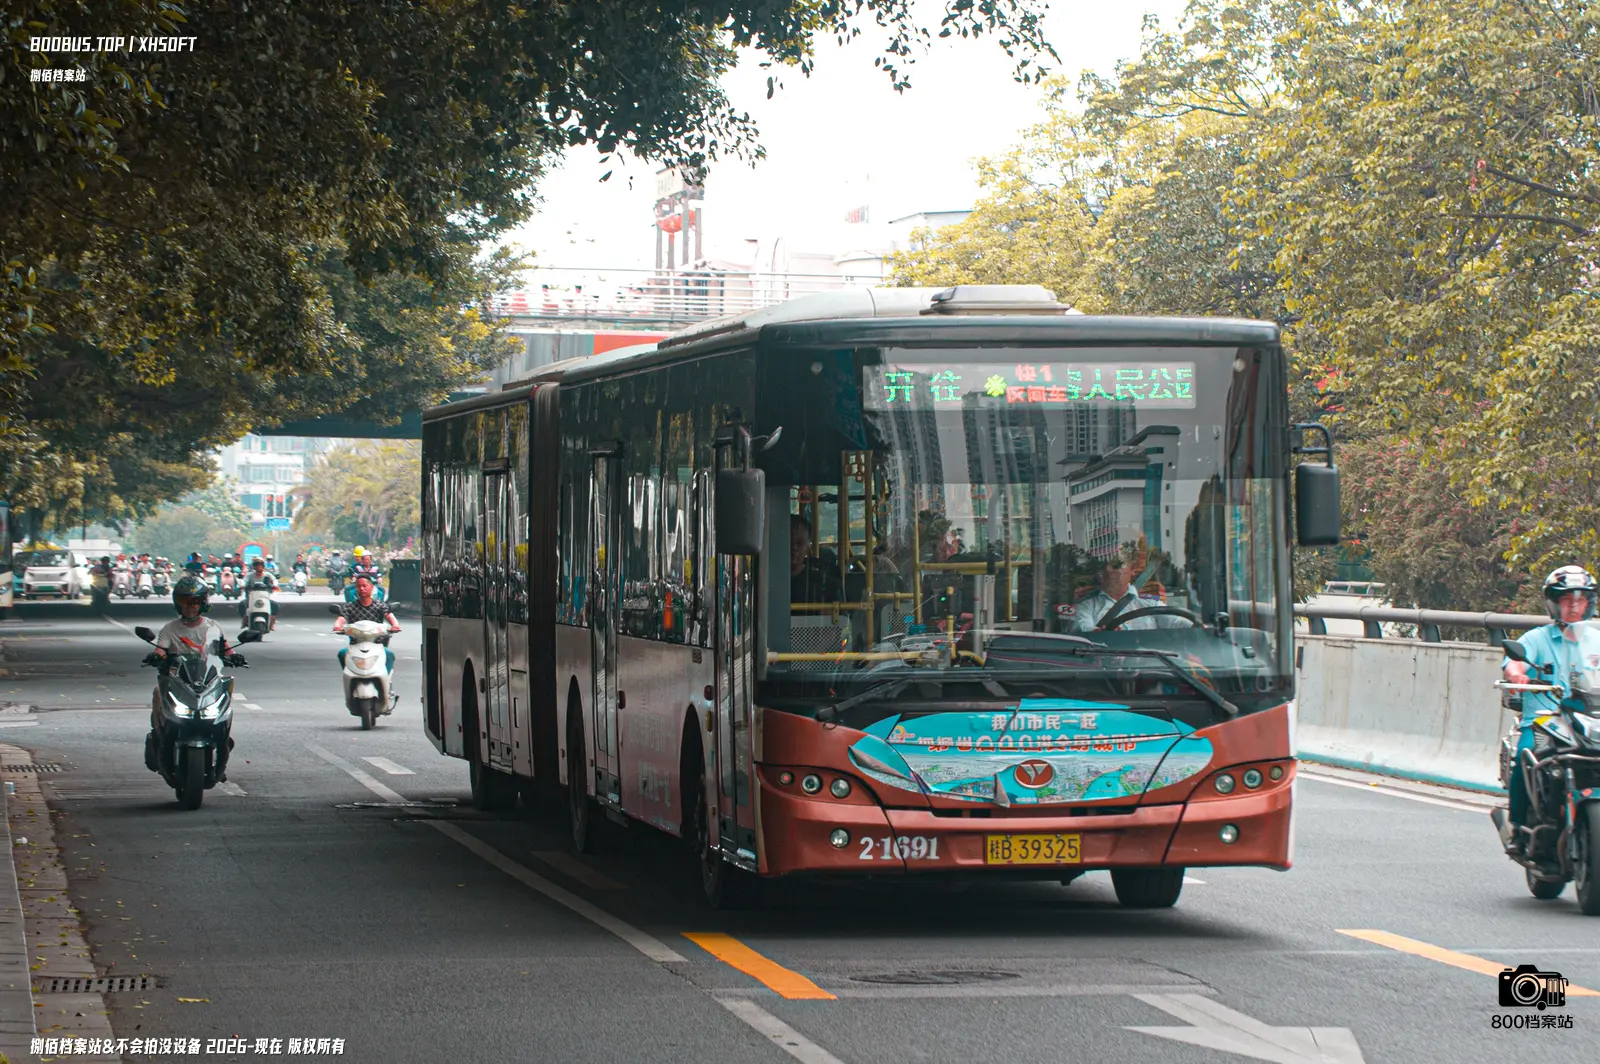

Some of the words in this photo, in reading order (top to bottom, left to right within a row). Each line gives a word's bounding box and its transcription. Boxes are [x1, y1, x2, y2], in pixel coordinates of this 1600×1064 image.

[991, 712, 1097, 731] 我们市民一起
